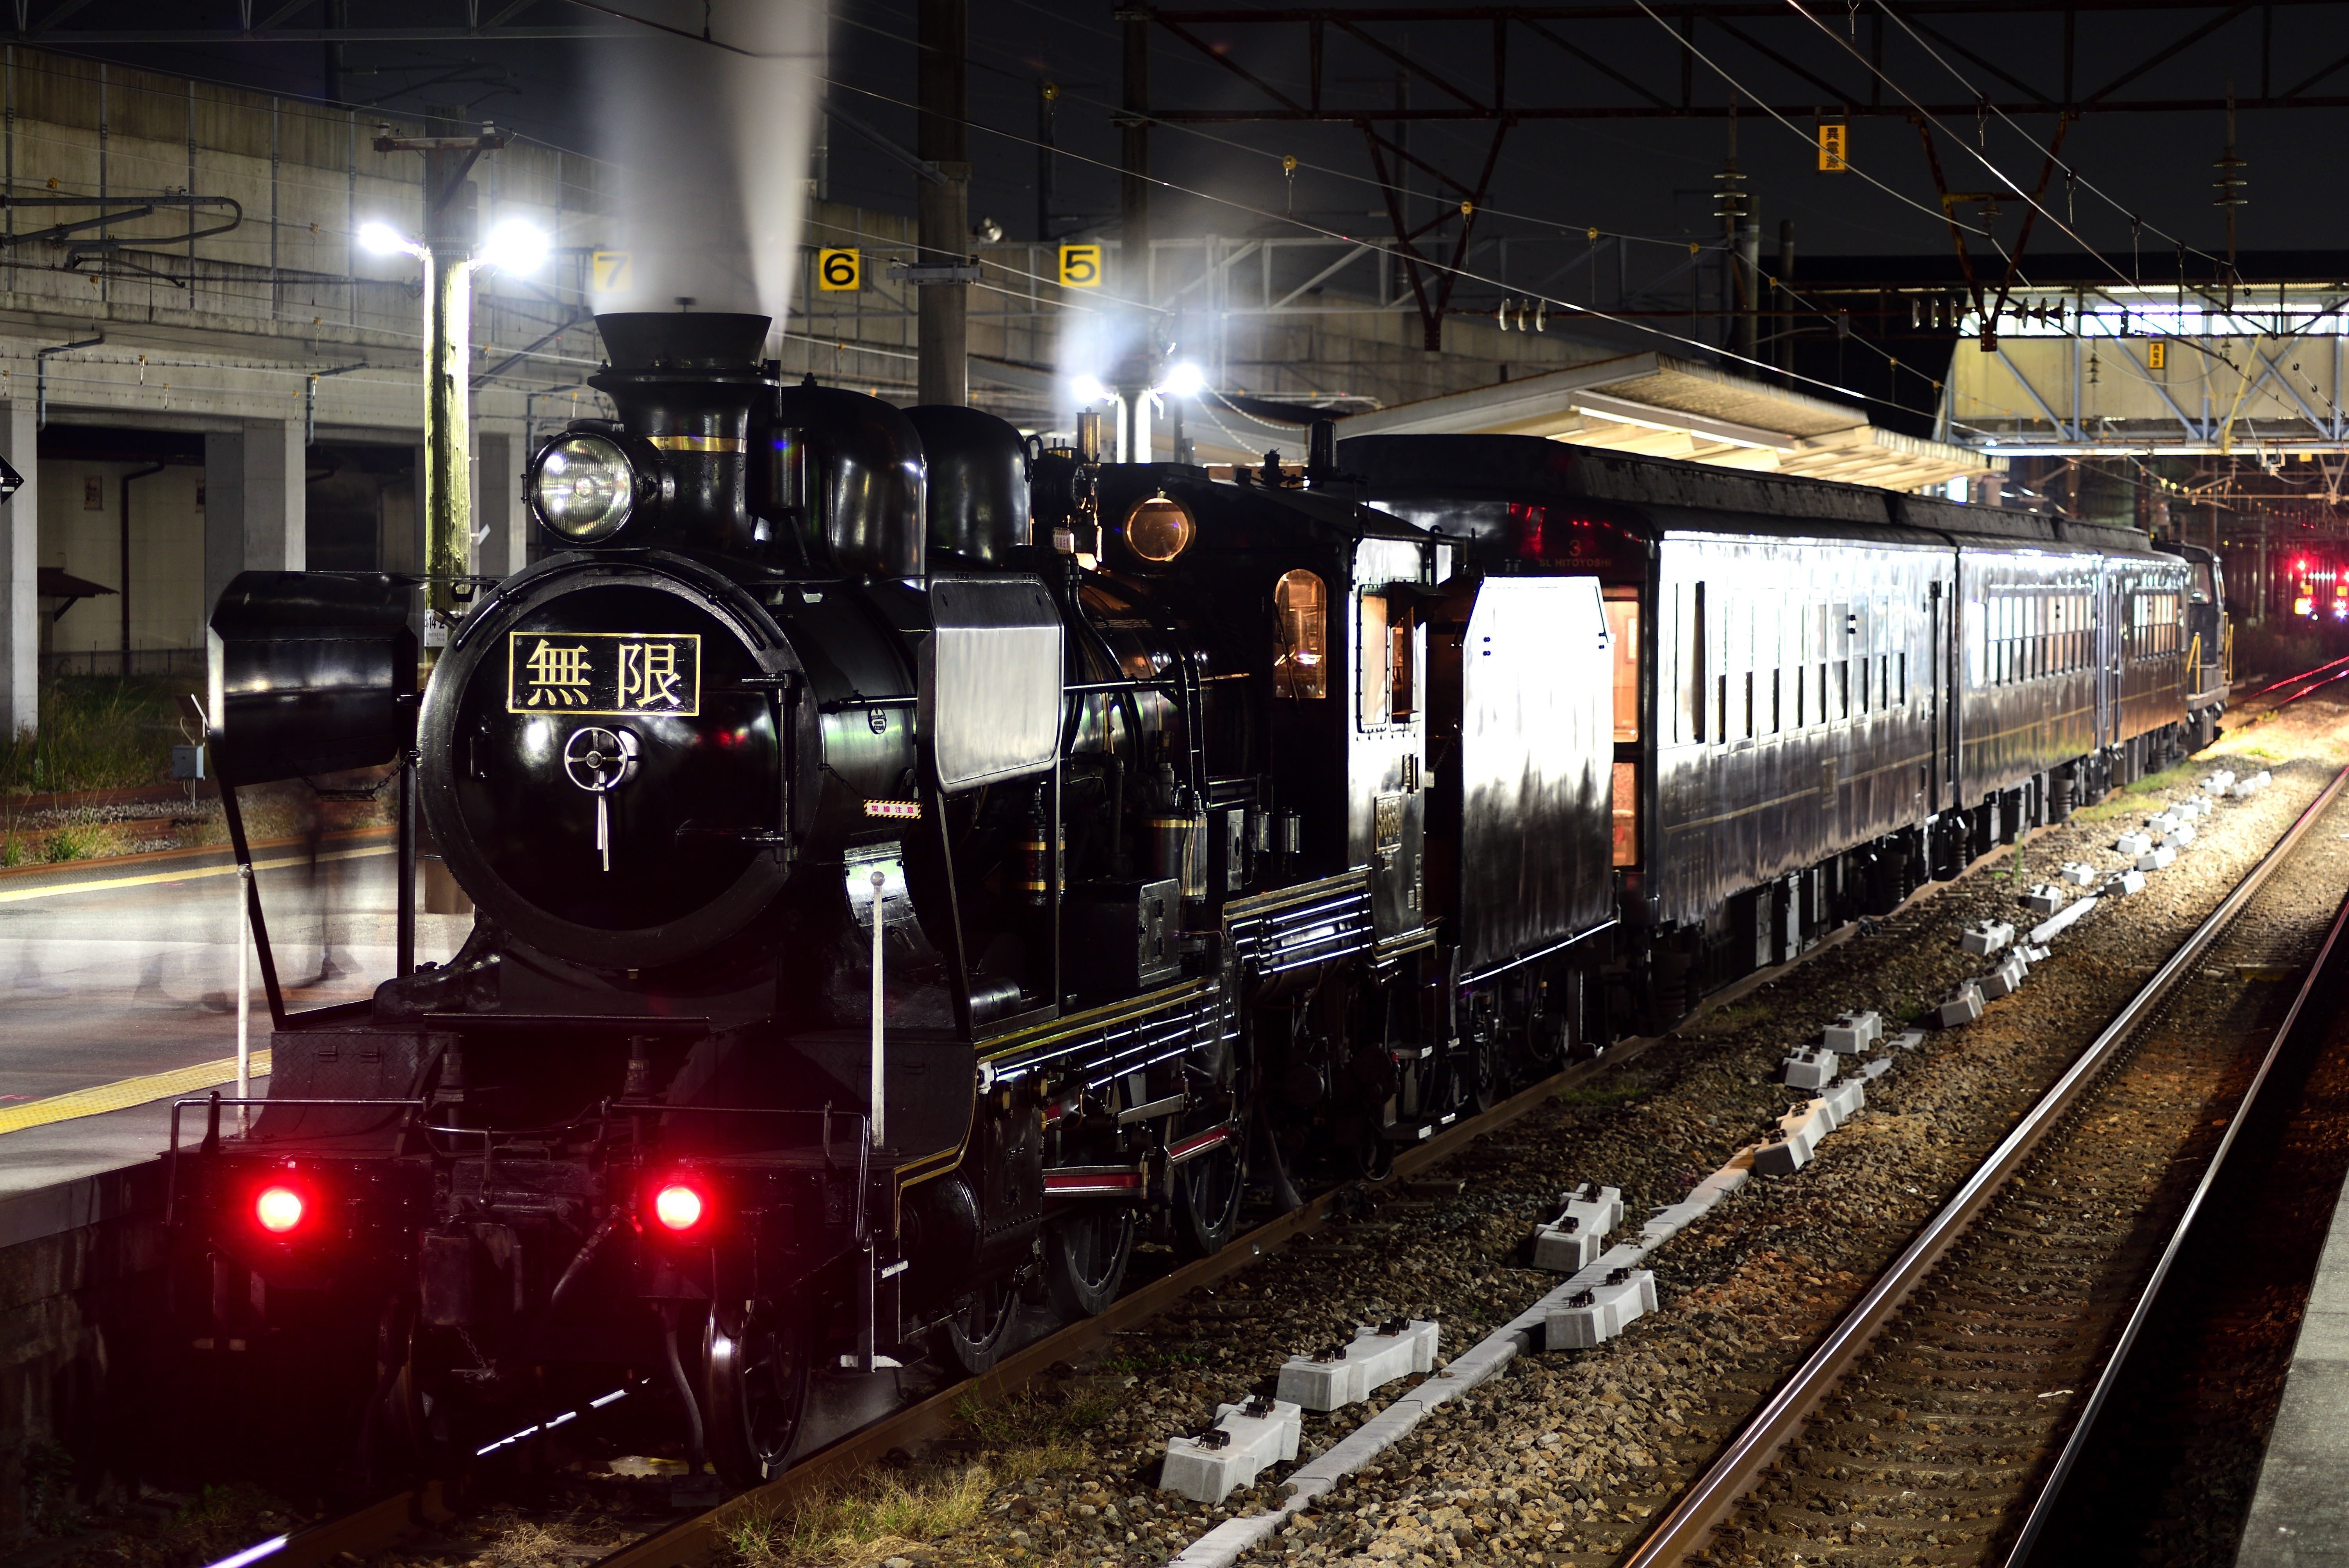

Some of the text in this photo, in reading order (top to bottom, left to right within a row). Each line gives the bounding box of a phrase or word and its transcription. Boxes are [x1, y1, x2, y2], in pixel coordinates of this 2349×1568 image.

[598, 256, 627, 288] 7
[824, 253, 854, 286] 6
[1065, 250, 1095, 283] 5
[1539, 559, 1612, 567] SL HITOYOSHI
[1569, 539, 1581, 556] 3
[526, 638, 681, 707] 無限
[871, 805, 914, 814] 架線注意
